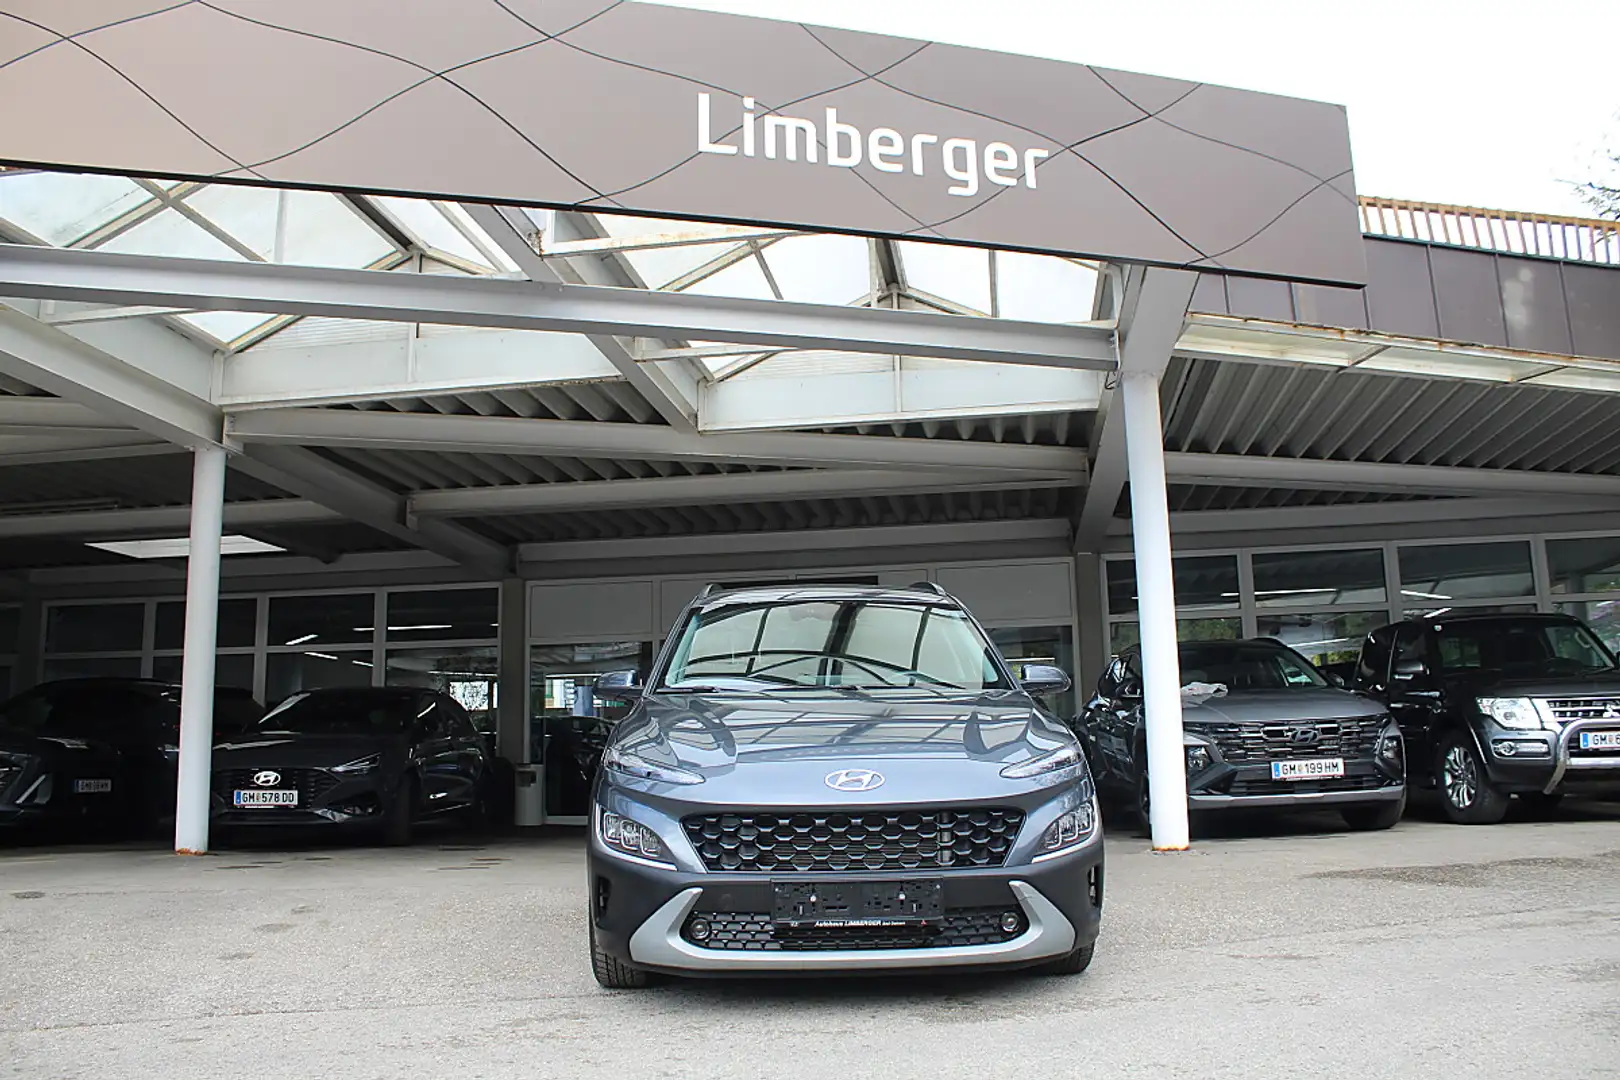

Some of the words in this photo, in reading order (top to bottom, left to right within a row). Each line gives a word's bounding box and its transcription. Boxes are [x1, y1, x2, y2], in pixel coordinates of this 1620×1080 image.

[697, 92, 1049, 197] Limberger
[1592, 734, 1607, 745] GM
[1282, 764, 1296, 775] GM
[1305, 762, 1323, 774] 199
[1325, 761, 1339, 773] HM
[242, 792, 255, 803] GM
[261, 792, 280, 803] 578
